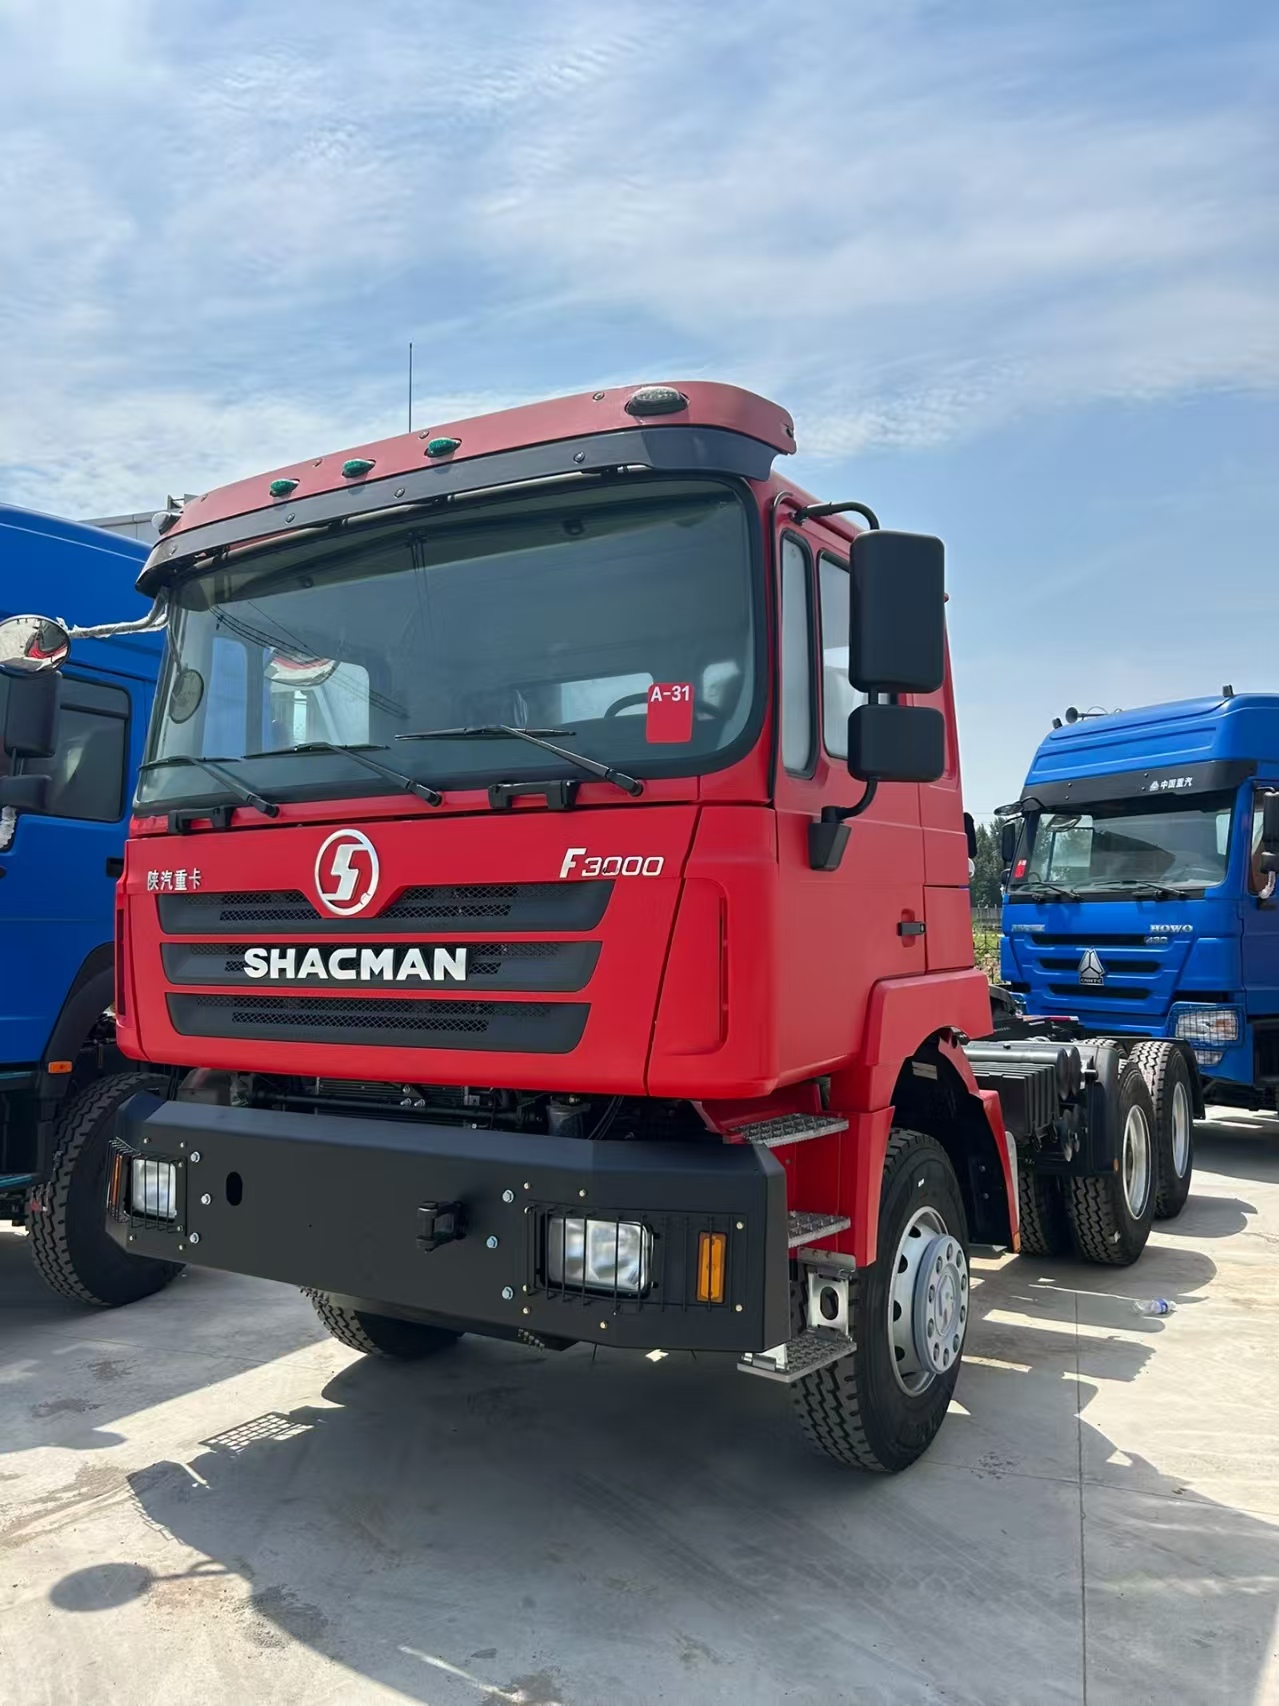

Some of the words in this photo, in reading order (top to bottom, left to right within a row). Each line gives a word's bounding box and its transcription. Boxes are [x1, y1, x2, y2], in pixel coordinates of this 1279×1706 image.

[650, 685, 690, 702] A-31
[1160, 776, 1193, 790] 中国重汽
[559, 847, 665, 879] F3000
[147, 867, 202, 891] 陕汽重卡
[1150, 924, 1193, 933] HOWO
[243, 947, 467, 981] SHACMAN
